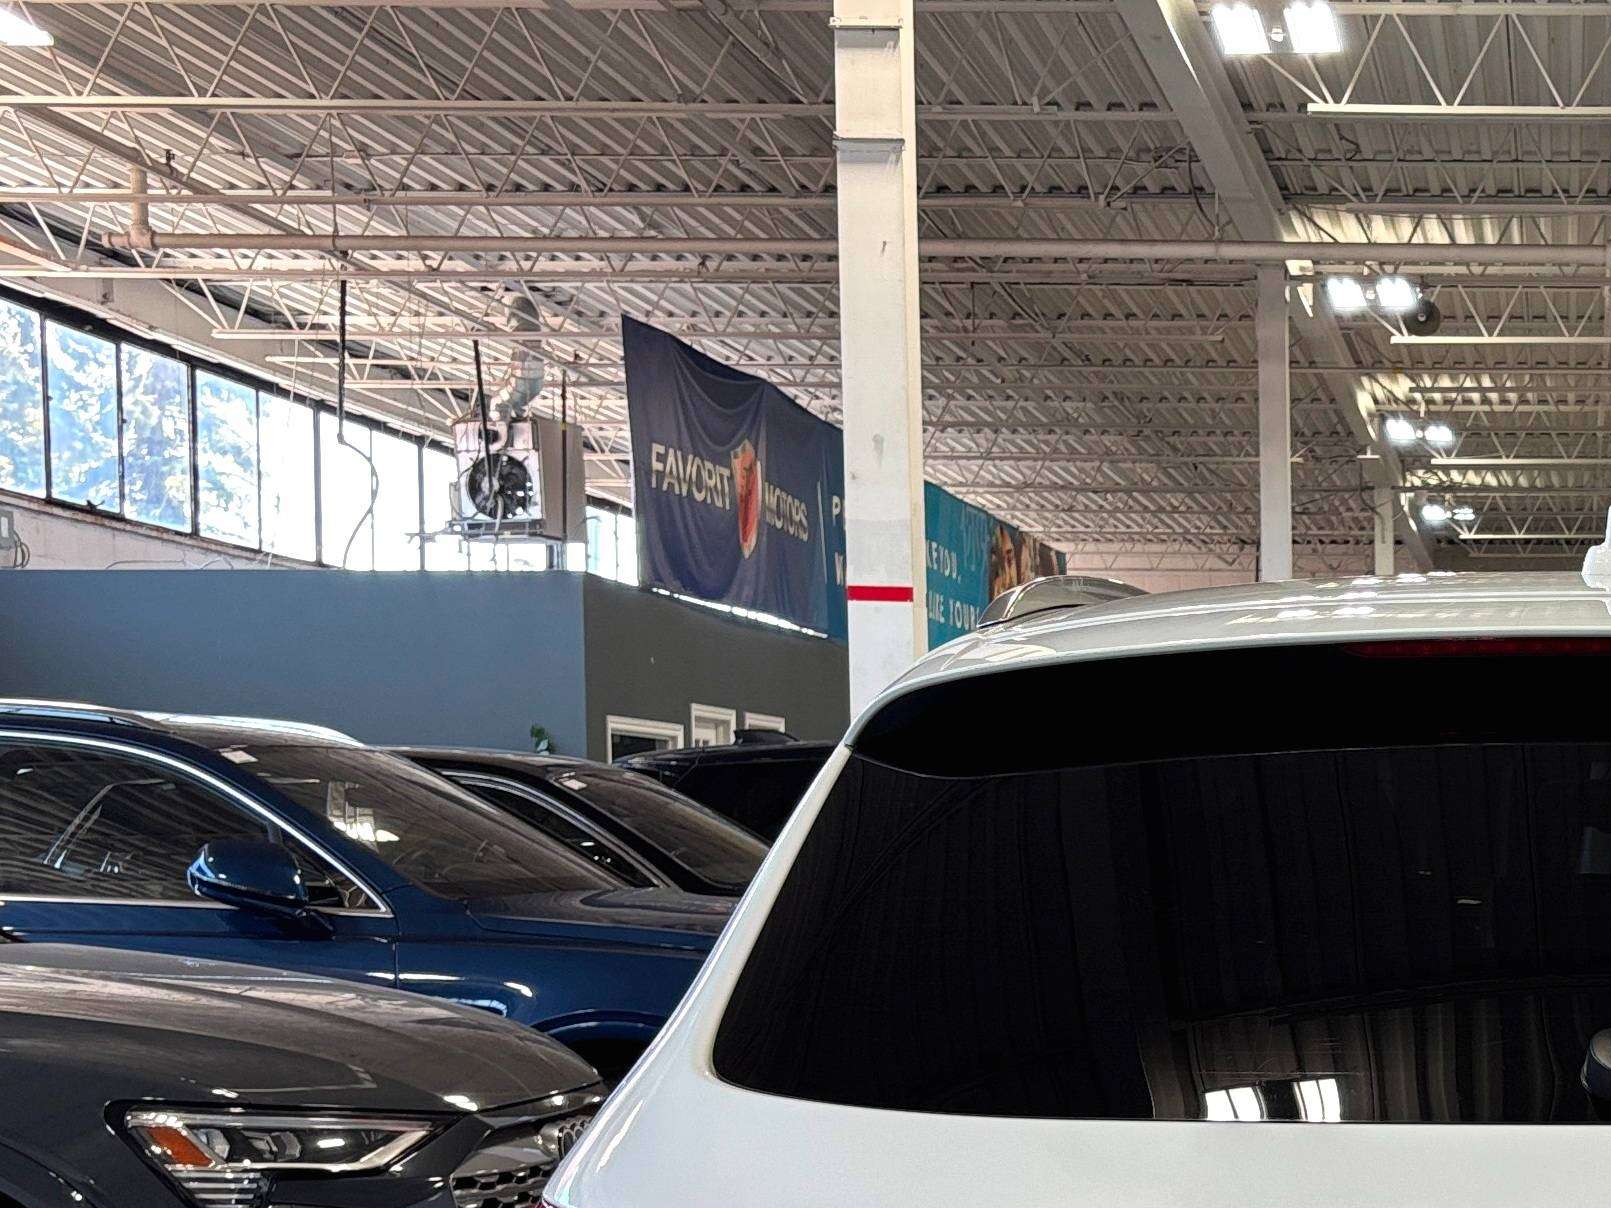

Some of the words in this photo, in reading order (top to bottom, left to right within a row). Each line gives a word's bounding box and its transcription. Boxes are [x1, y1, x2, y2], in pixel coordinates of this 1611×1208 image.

[650, 442, 731, 510] FAVORIT
[763, 481, 809, 542] MOTORS
[949, 598, 980, 631] YOUR
